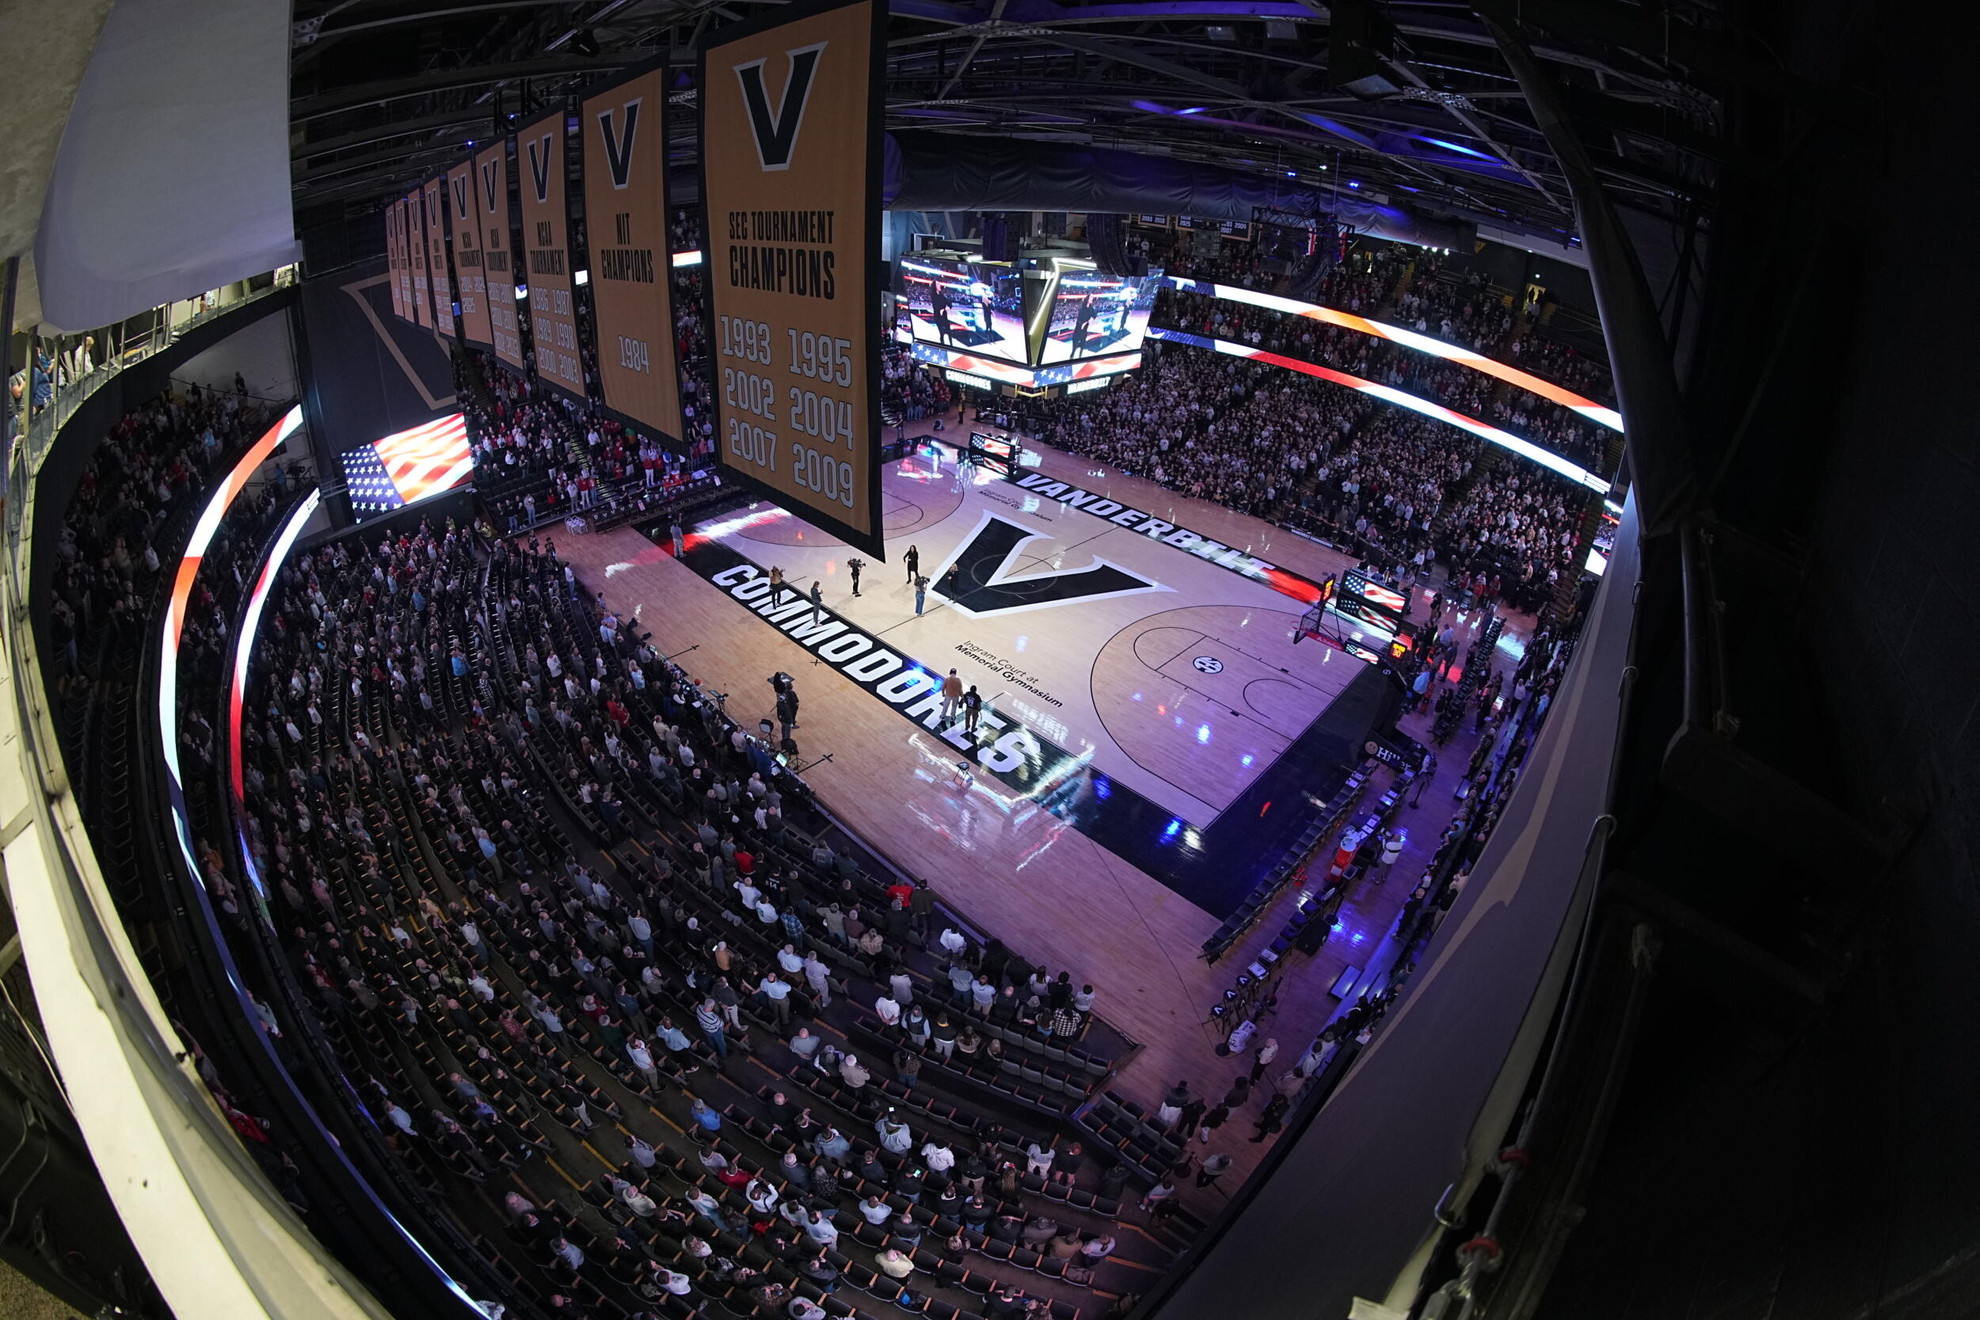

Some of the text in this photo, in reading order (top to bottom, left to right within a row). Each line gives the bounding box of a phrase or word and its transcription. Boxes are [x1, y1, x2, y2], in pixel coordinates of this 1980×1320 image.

[732, 40, 829, 172] V
[526, 132, 553, 204] V
[596, 97, 643, 190] V
[427, 188, 437, 228] V
[452, 173, 467, 220] V
[482, 157, 498, 214] V
[410, 198, 418, 234] V
[536, 221, 552, 247] NCAA
[616, 213, 630, 245] NIT
[729, 210, 835, 244] SEC TOURNAMENT
[530, 249, 566, 276] TOURNAMENT
[601, 249, 654, 284] CHAMPIONS
[730, 245, 835, 300] CHAMPIONS
[532, 287, 571, 317] 1986 1987
[618, 335, 650, 374] 1984
[720, 315, 852, 388] 1993 1995
[724, 367, 854, 450] 2002 2004
[729, 417, 854, 509] 2007 2009
[1015, 472, 1276, 577] VANDERBILT
[929, 508, 1179, 619] V
[712, 564, 1042, 773] COMMODORES
[955, 644, 1063, 708] Memorial Gymnasium
[963, 640, 1039, 684] Ingram Court at
